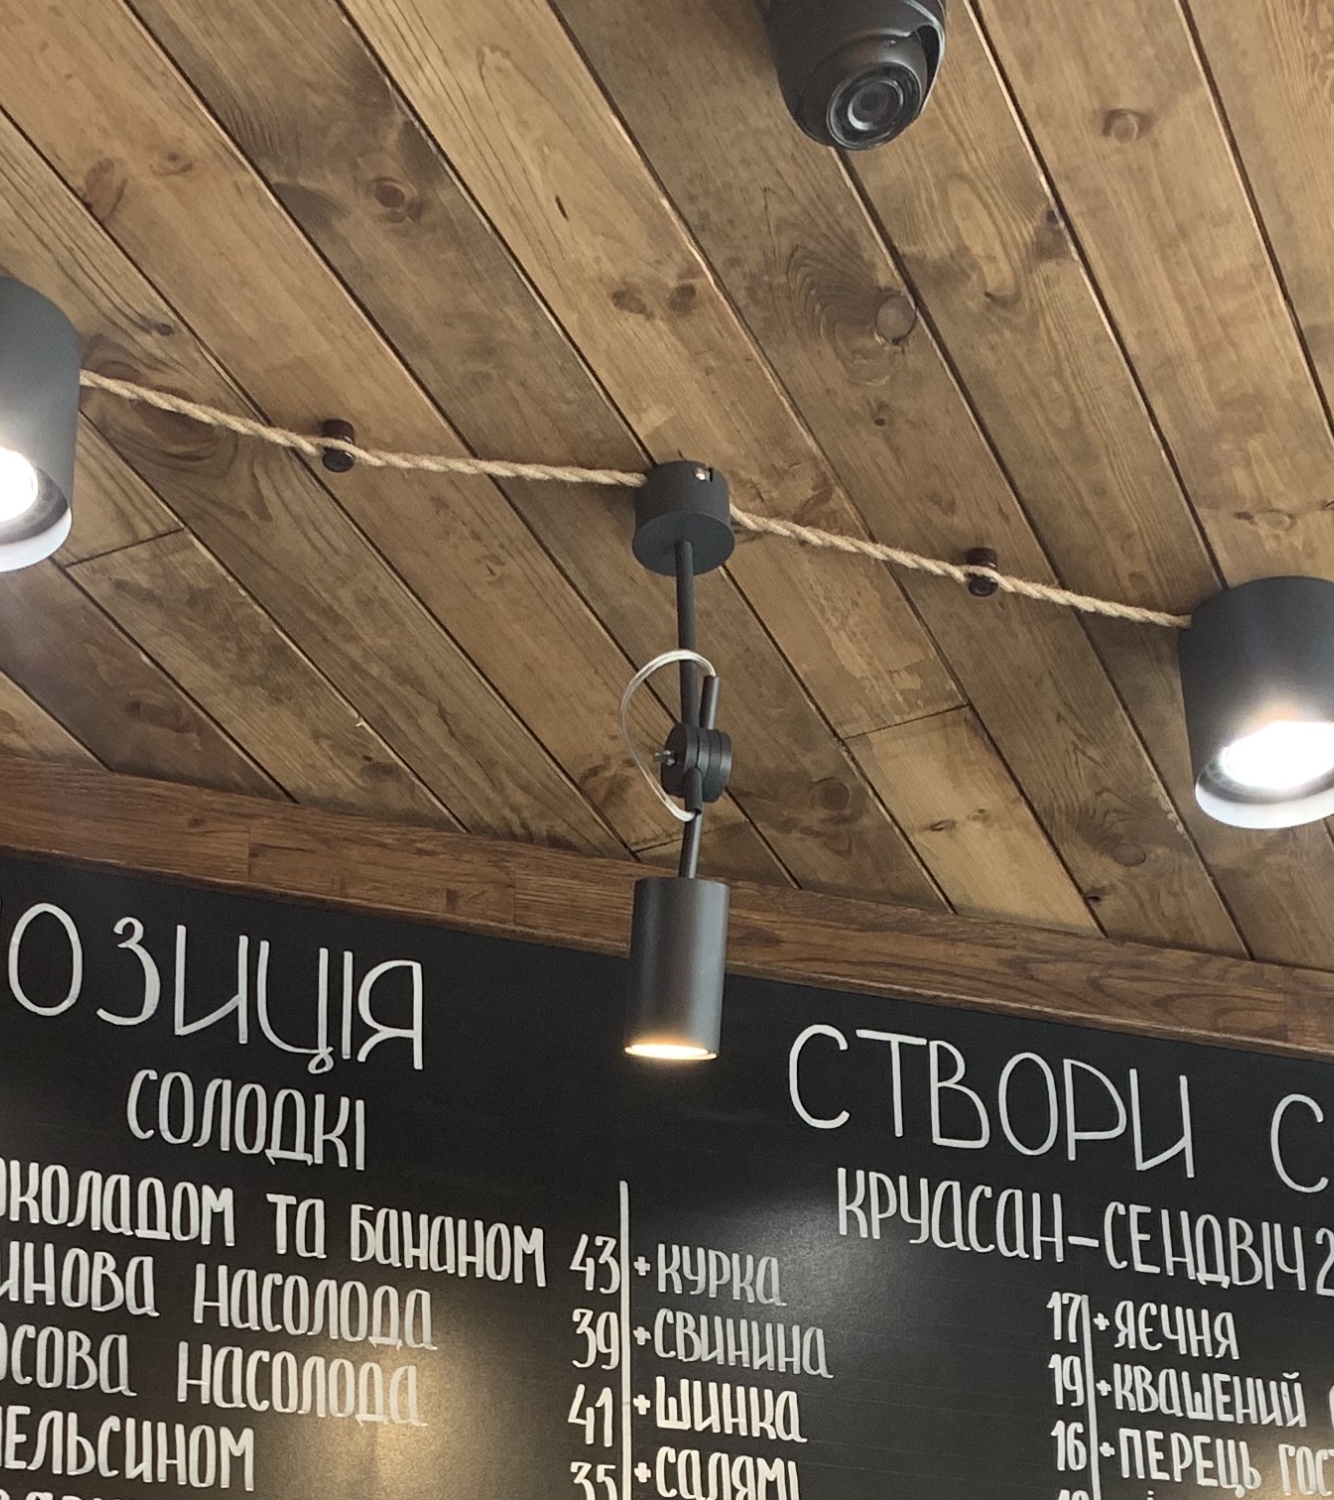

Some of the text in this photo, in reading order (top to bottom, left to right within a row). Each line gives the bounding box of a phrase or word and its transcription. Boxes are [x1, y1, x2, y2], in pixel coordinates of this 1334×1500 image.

[126, 1068, 366, 1171] СОЛОДКІ
[789, 1024, 1195, 1178] СТВОРИ
[266, 1194, 327, 1259] ТА
[350, 1203, 547, 1288] БАНАНОМ
[570, 1233, 621, 1295] 43
[193, 1262, 438, 1350] НАСОЛОДА
[572, 1308, 621, 1371] 39
[1046, 1291, 1082, 1343] 17
[177, 1341, 428, 1427] НАСОЛОДА
[567, 1383, 614, 1448] 41
[1047, 1353, 1084, 1408] 19
[1050, 1419, 1087, 1471] 16
